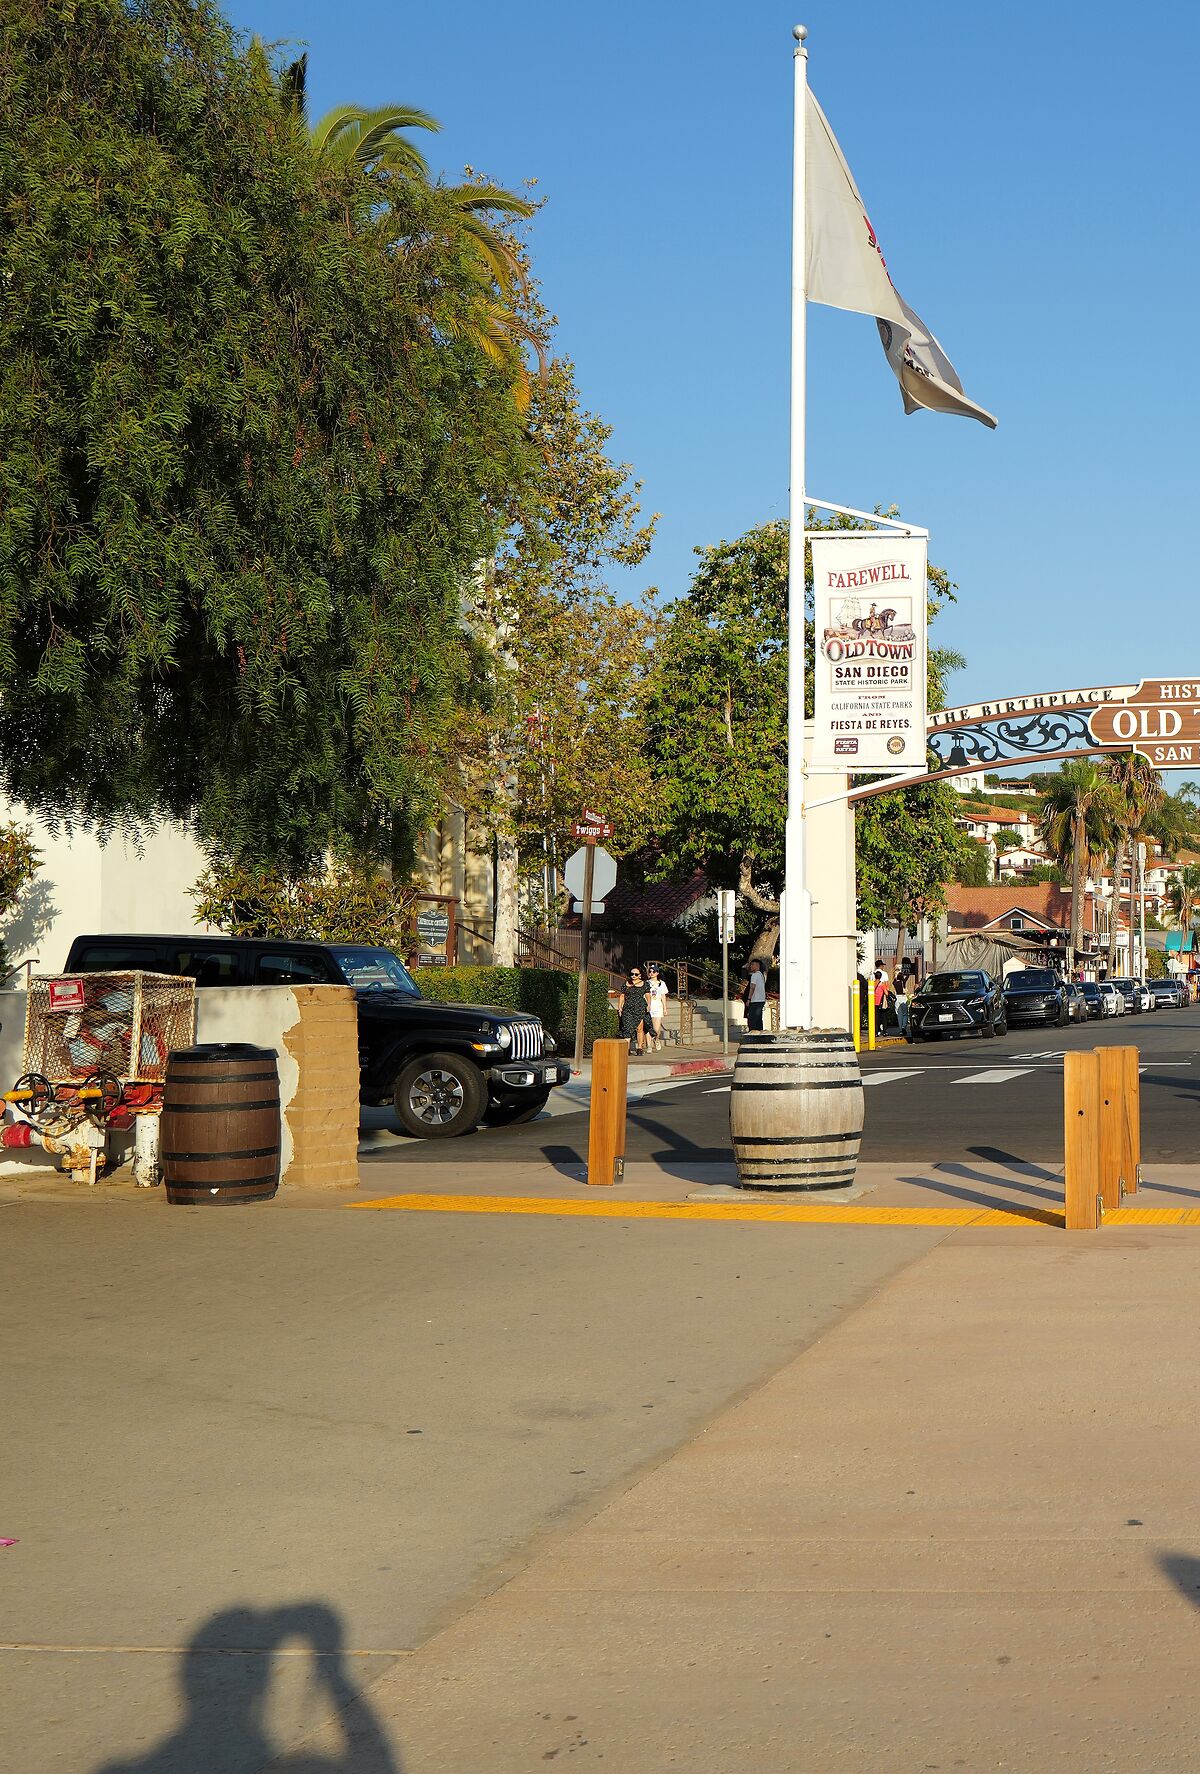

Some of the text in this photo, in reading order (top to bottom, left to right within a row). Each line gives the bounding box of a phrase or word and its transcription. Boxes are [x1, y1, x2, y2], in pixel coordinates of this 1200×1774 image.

[827, 564, 910, 588] FAREWELL
[826, 640, 913, 661] OLD TOWN
[835, 665, 909, 678] SAN DIEGO
[831, 701, 913, 710] CALIFORNIA STATE PARKS
[929, 689, 1113, 727] THE BIRTHPLACE
[831, 721, 863, 730] FIESTA
[866, 720, 877, 729] DE
[1112, 709, 1182, 738] OLD
[1155, 747, 1193, 761] SAN
[576, 825, 601, 836] Twiggs
